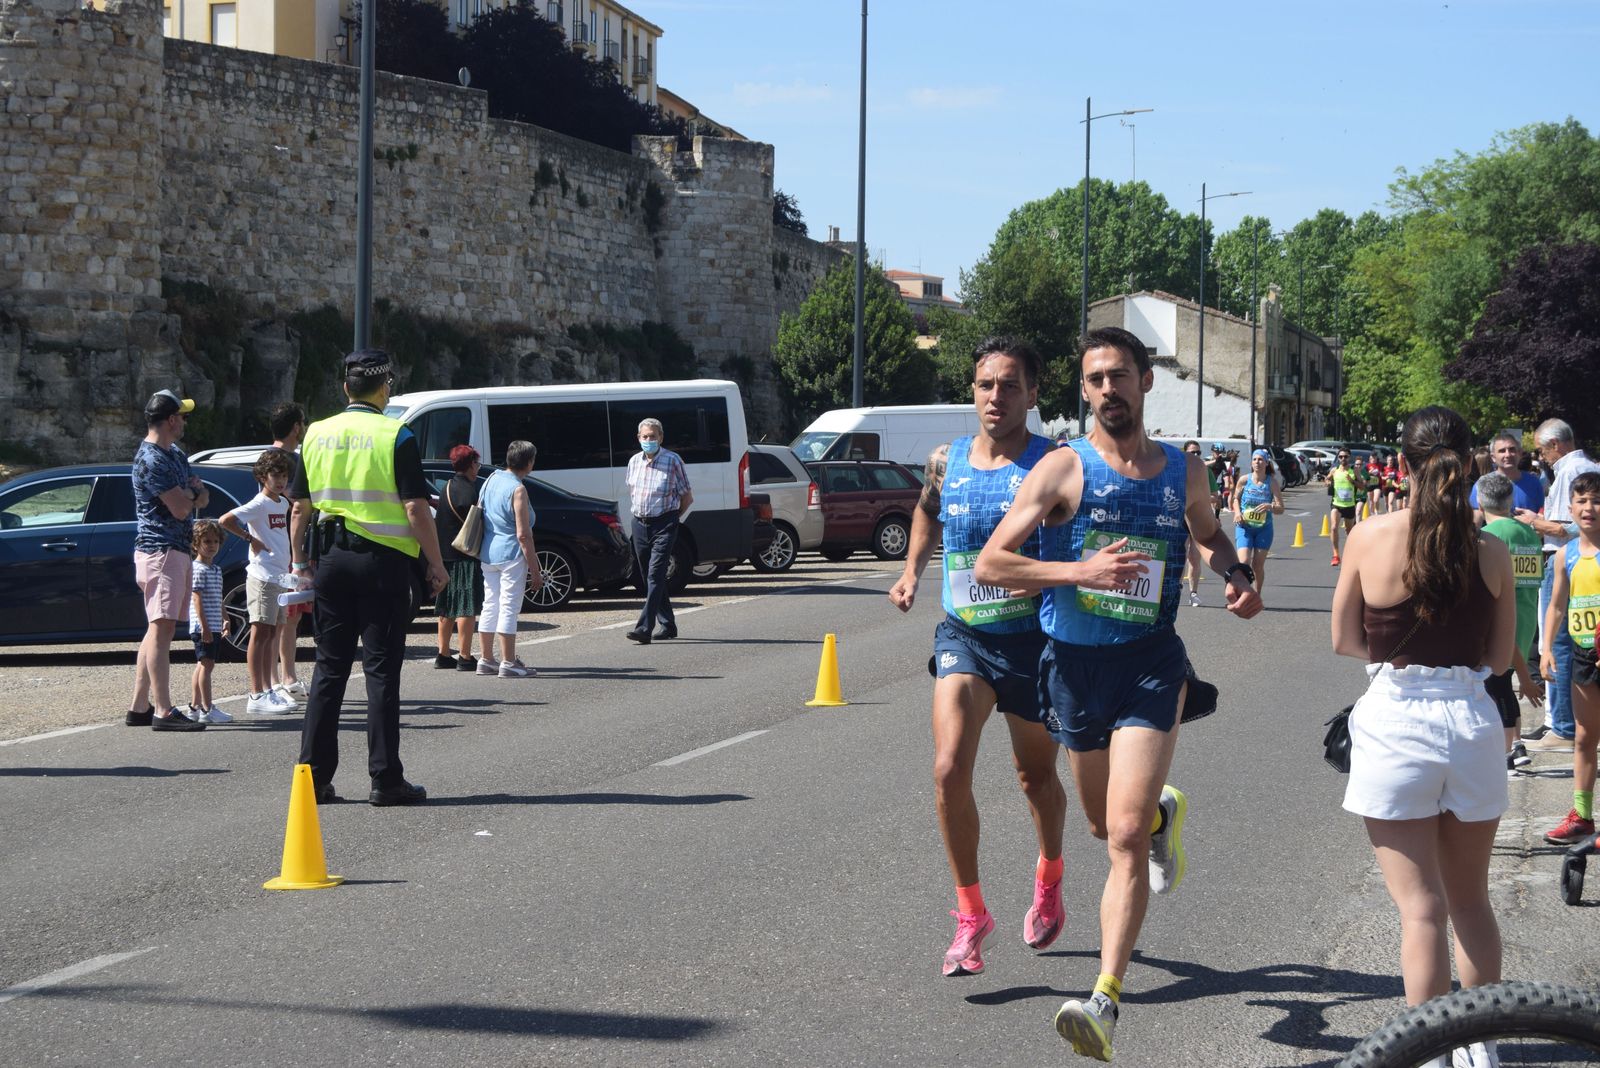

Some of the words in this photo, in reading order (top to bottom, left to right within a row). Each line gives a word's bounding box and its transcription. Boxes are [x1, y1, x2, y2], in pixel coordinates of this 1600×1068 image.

[318, 432, 374, 450] POLICÍA
[1112, 537, 1158, 551] FDACION
[1514, 557, 1537, 574] 1026
[1109, 577, 1151, 598] ETO
[977, 609, 997, 618] CAJA
[999, 603, 1029, 615] RURAL
[1101, 601, 1124, 613] CAJA
[1126, 605, 1154, 617] RURAL
[1573, 611, 1600, 632] 30
